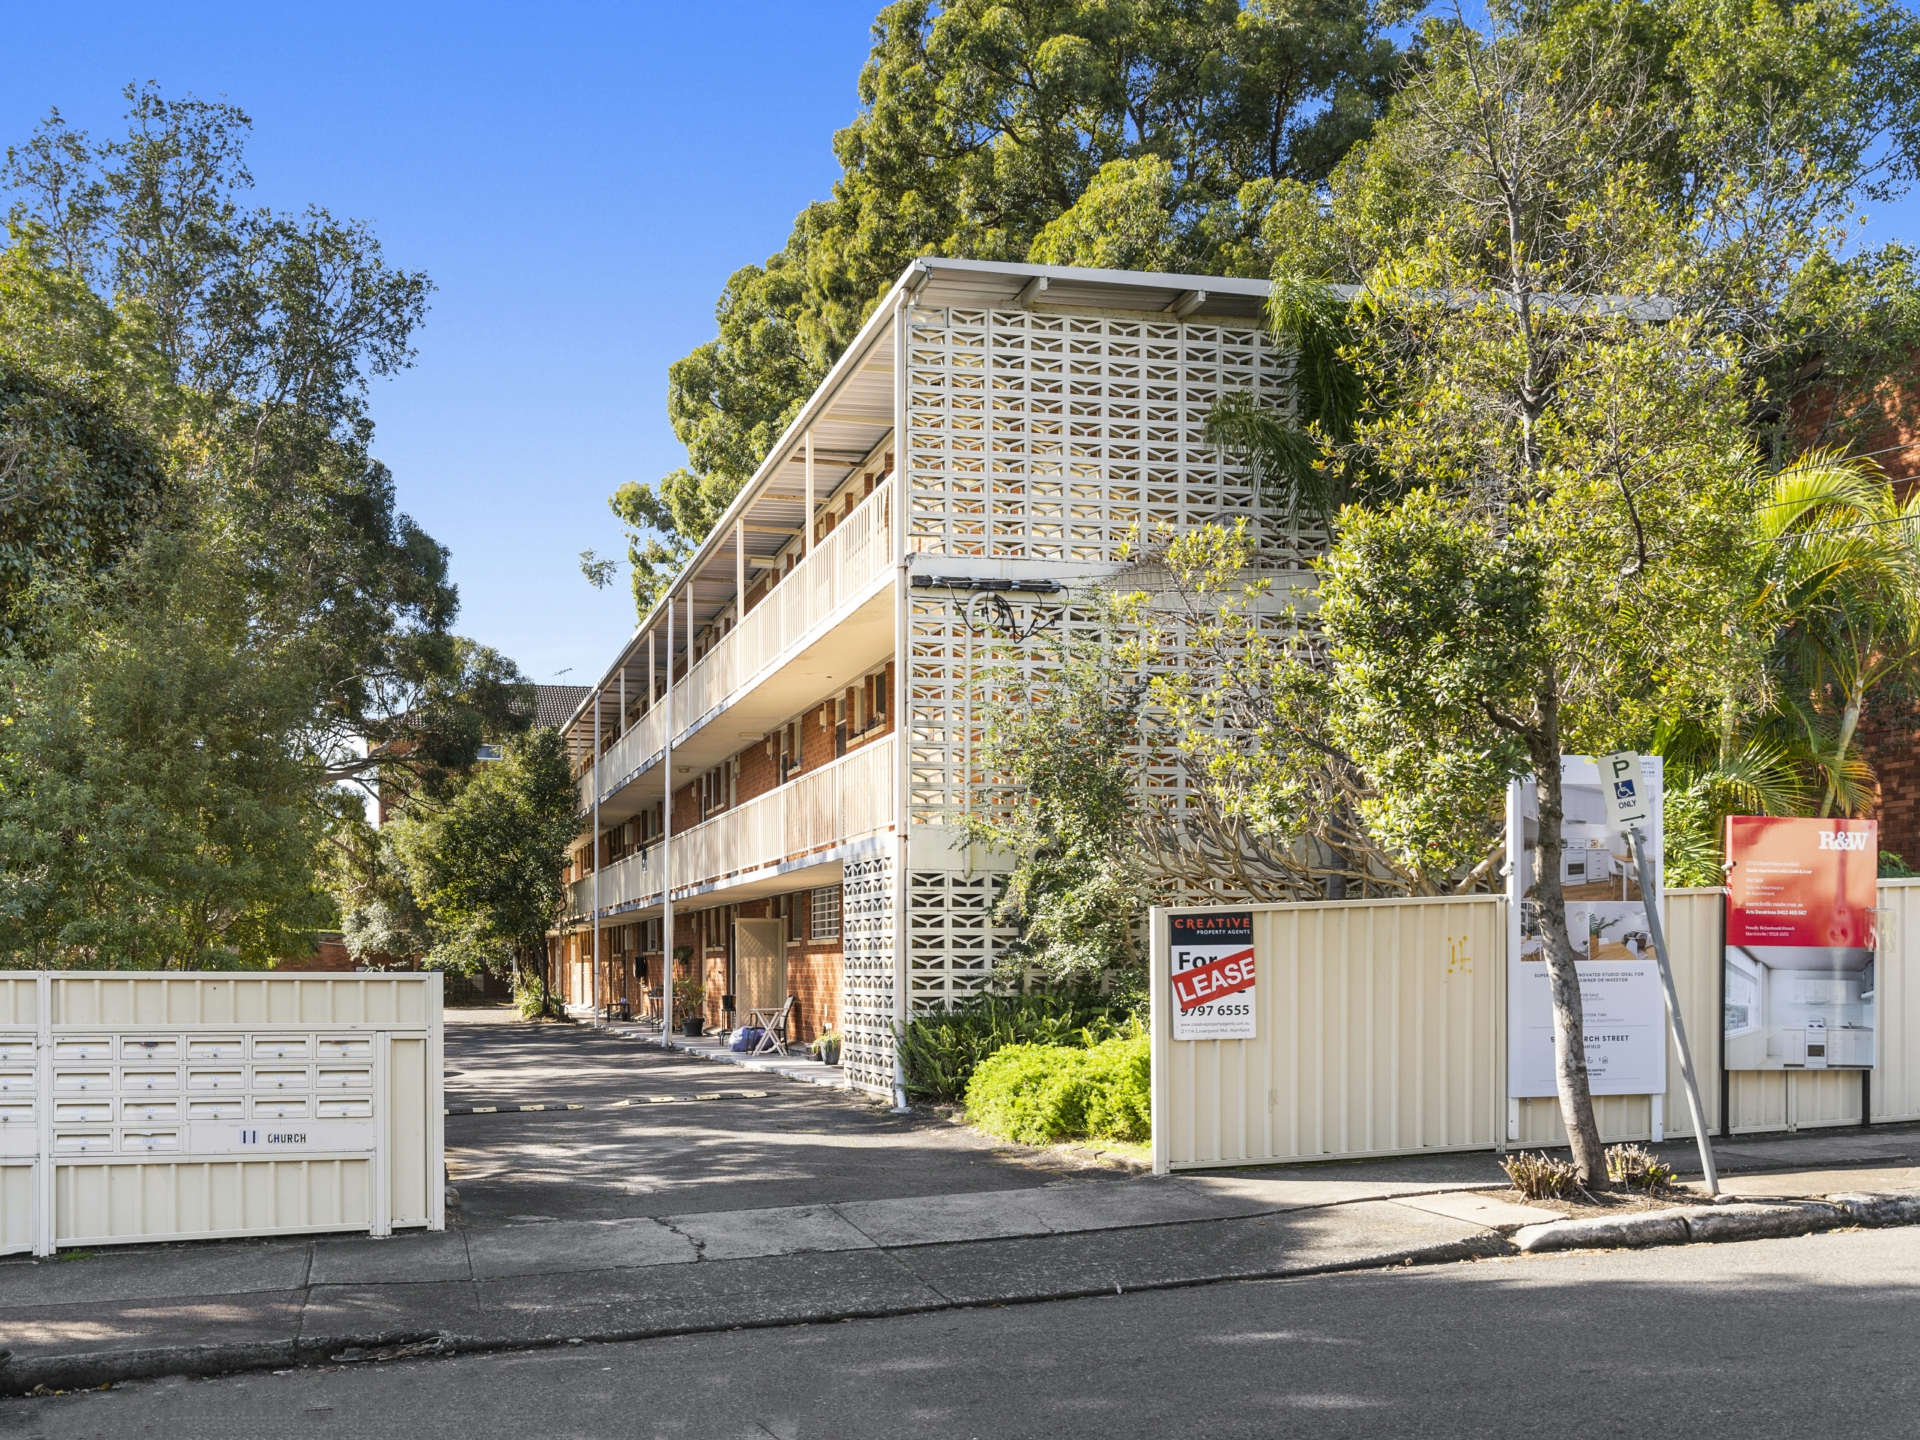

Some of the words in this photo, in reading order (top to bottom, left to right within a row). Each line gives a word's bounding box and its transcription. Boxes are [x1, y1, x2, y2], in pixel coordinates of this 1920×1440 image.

[1612, 760, 1630, 779] P
[1618, 800, 1637, 809] ONLY
[1818, 831, 1869, 851] R&W
[1174, 917, 1251, 930] CREATIVE
[1178, 952, 1218, 970] For
[1176, 957, 1256, 1003] LEASE
[1180, 1006, 1214, 1017] 9797
[1217, 1005, 1250, 1016] 6555
[267, 1133, 307, 1144] CHURCH
